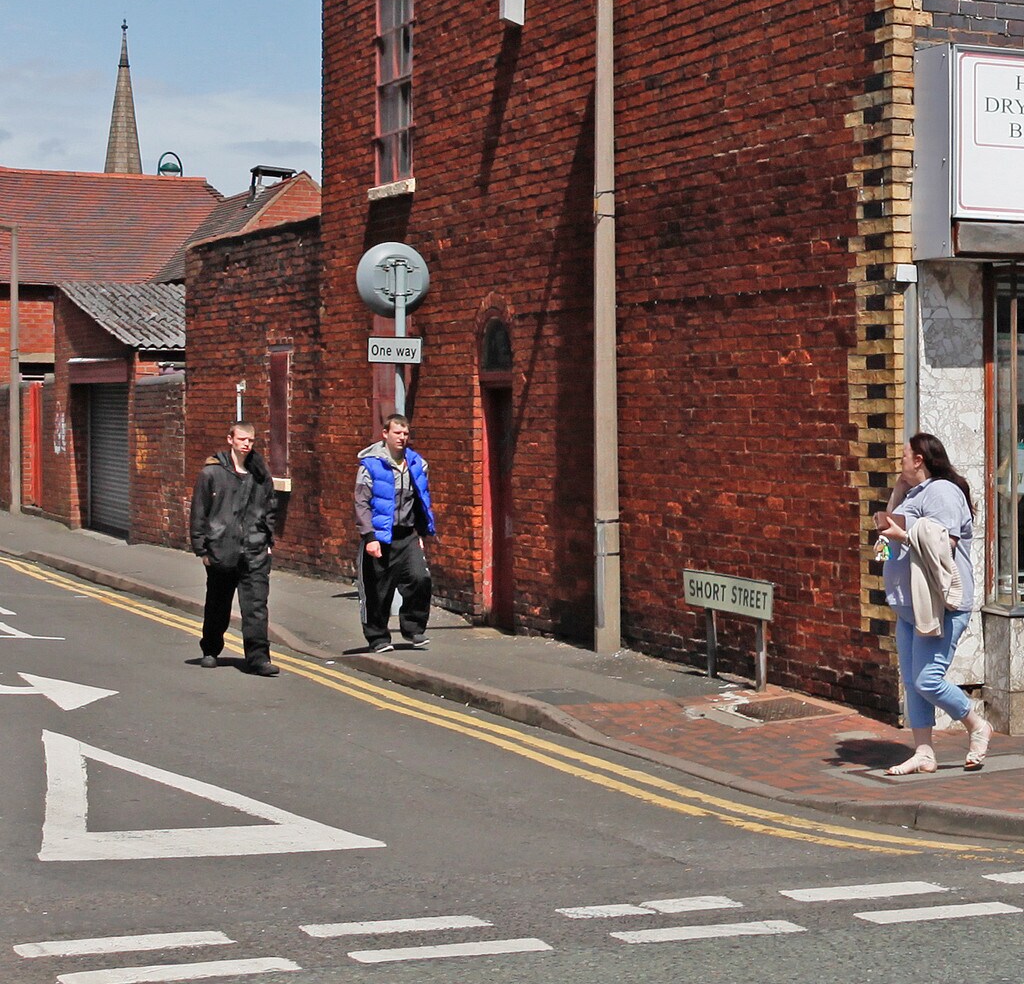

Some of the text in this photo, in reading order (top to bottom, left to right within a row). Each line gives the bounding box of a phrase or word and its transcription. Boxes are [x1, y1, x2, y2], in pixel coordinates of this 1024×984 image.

[371, 344, 417, 359] One way
[689, 579, 768, 610] SHORT STREET
